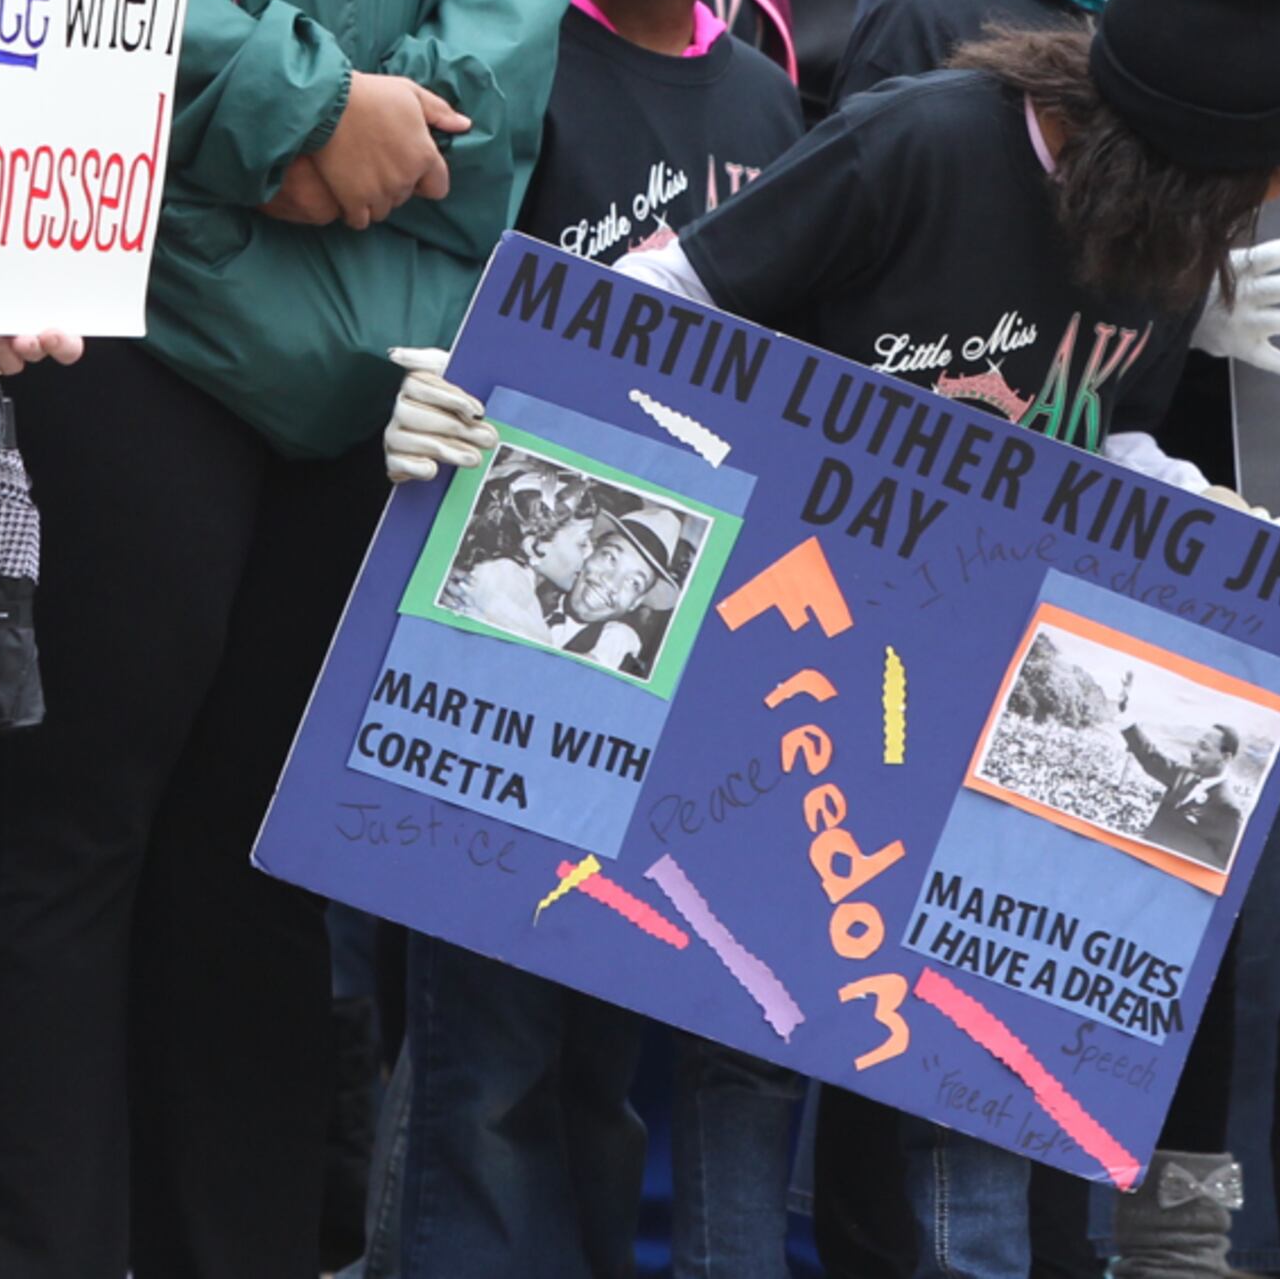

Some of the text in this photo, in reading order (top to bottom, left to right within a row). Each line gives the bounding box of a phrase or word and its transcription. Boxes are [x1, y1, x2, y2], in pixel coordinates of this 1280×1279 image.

[560, 200, 632, 260] Little
[632, 160, 688, 221] Miss
[871, 332, 954, 374] Little
[961, 310, 1038, 362] Miss
[497, 252, 771, 404] MARTIN
[780, 354, 1036, 511] LUTHER
[1041, 461, 1218, 578] KING
[799, 456, 950, 562] DAY
[955, 525, 1060, 585] Have
[1073, 551, 1102, 578] a
[356, 721, 530, 811] CORETTA
[372, 667, 652, 784] MARTIN WITH
[334, 800, 518, 875] Justice
[647, 756, 782, 846] Peace
[714, 535, 911, 1072] Freedom
[907, 912, 1185, 1040] I HAVE A DREAM
[924, 870, 1184, 1000] MARTIN GIVES
[1060, 1021, 1159, 1094] Speech
[980, 1086, 1014, 1128] at
